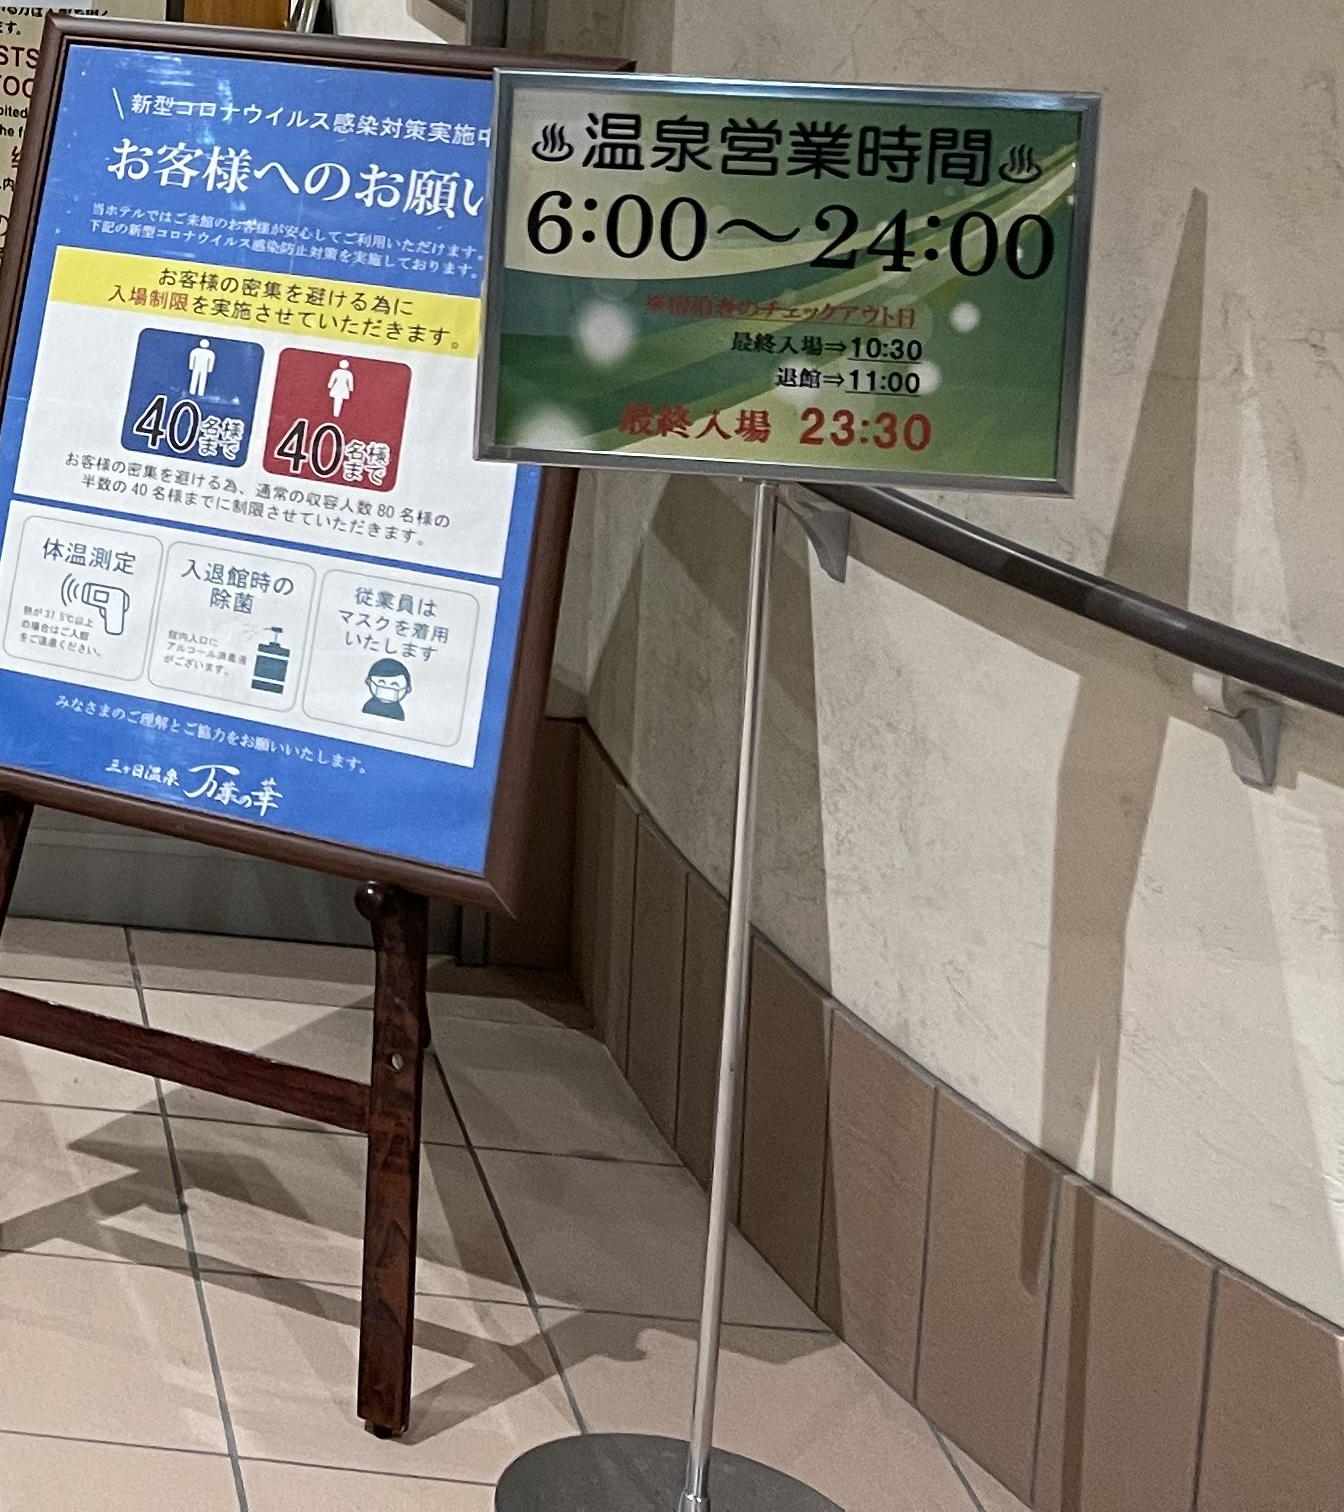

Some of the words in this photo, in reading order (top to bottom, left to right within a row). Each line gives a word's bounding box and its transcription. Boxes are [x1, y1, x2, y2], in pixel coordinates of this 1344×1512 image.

[580, 110, 994, 188] 温泉営業時間
[157, 267, 413, 317] お客様の密集を避ける為に
[108, 284, 460, 350] 入場制限を実施させていただきます。
[850, 336, 923, 361] 10:30
[774, 366, 821, 388] 退館
[849, 368, 921, 394] 11:00
[618, 402, 772, 444] 最終入場
[799, 405, 933, 453] 23:30
[42, 536, 137, 576] 体温測定
[181, 558, 295, 597] 入退館時の
[209, 587, 255, 615] 除菌
[355, 586, 438, 618] 従業員は
[338, 609, 450, 645] マスクを着用
[166, 641, 248, 666] アルコール消毒液
[344, 630, 439, 663] いたします
[55, 694, 367, 775] みなさまのご理解とご協力をお願いいたします。
